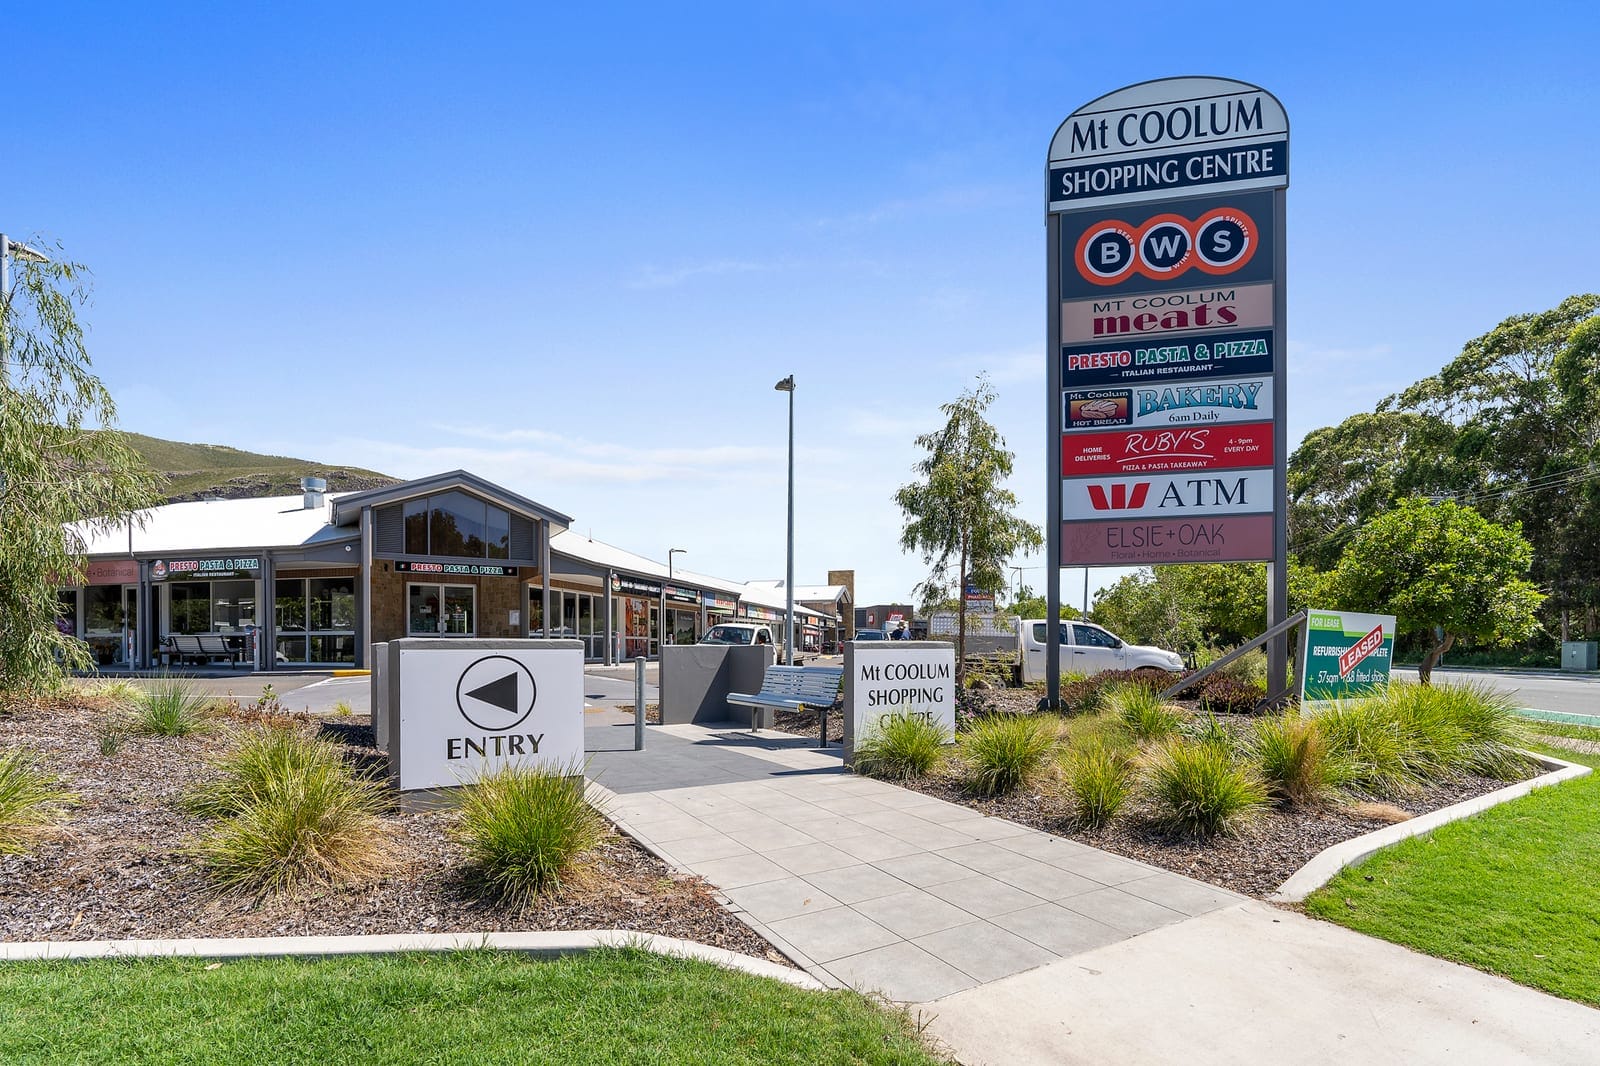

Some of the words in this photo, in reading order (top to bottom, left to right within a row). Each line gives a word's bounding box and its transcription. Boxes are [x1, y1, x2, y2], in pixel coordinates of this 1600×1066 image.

[1070, 118, 1108, 153] Mt
[1117, 97, 1263, 146] COOLUM
[1062, 160, 1178, 195] SHOPPING
[1185, 148, 1273, 180] CENTRE
[1225, 215, 1249, 237] SPIRITS
[1172, 250, 1191, 269] WINE
[1093, 301, 1126, 313] MT
[1132, 290, 1236, 309] COOLUM
[1093, 304, 1238, 335] meats
[1068, 351, 1132, 371] PRESTO
[1135, 345, 1190, 365] PASTA
[1195, 343, 1210, 361] &
[1214, 338, 1268, 359] PIZZA
[1121, 368, 1155, 377] ITALIAN
[1156, 363, 1214, 375] RESTAURANT
[1087, 391, 1129, 399] Coolum
[1137, 382, 1263, 417] BAKERY
[1093, 418, 1127, 426] BREAD
[1168, 412, 1191, 422] 6am
[1193, 409, 1220, 423] Daily
[1125, 429, 1210, 454] RUBY'S
[1074, 454, 1111, 462] DELIVERIES
[1148, 462, 1169, 470] PASTA
[1170, 460, 1208, 468] TAKEAWAY
[1158, 477, 1249, 508] ATM
[1111, 551, 1136, 560] Floral
[1142, 551, 1171, 559] Home
[1177, 548, 1221, 558] Botanical
[169, 561, 199, 571] PRESTO
[200, 560, 225, 570] PASTA
[226, 559, 233, 569] &
[234, 558, 259, 569] PIZZA
[411, 563, 442, 572] PRESTO
[443, 564, 470, 574] PASTA
[471, 566, 478, 574] &
[479, 566, 504, 575] PIZZA
[1311, 617, 1323, 627] FOR
[1324, 619, 1339, 628] LEASE
[1341, 630, 1381, 672] LEASED
[861, 664, 880, 681] Mt
[884, 663, 949, 680] COOLUM
[868, 687, 943, 706] SHOPPING
[447, 734, 544, 760] ENTRY
